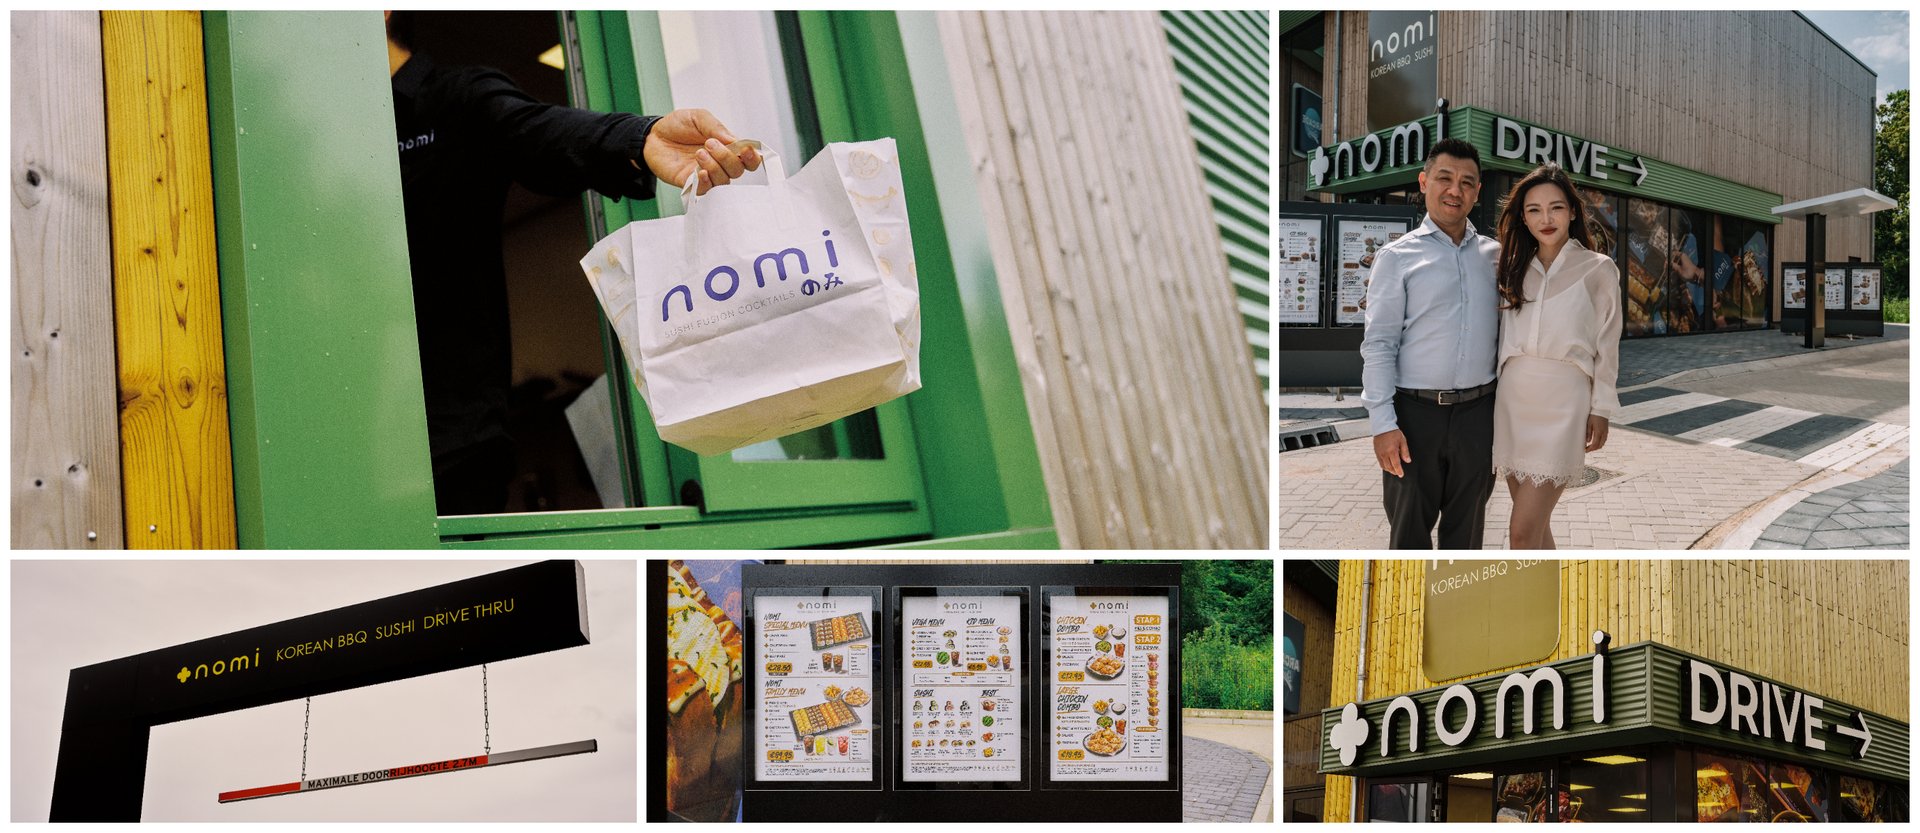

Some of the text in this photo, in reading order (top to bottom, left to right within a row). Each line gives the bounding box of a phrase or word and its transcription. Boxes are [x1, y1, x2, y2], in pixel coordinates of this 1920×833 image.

[1371, 9, 1434, 63] nomi
[1370, 45, 1434, 79] KOREAN BBQ SUSHI
[398, 129, 435, 152] nomi
[1334, 97, 1445, 180] nomi
[1496, 117, 1609, 180] DRIVE
[661, 229, 839, 322] nomi
[800, 272, 844, 296] のみ
[664, 290, 796, 339] SUSHI FUSION COCKTAILS
[1430, 569, 1479, 597] KOREAN
[1482, 560, 1508, 581] BBQ
[805, 601, 837, 610] nomi
[952, 601, 983, 610] nomi
[1098, 601, 1129, 610] nomi
[1136, 616, 1155, 624] STAP
[195, 598, 515, 680] nomi KOREAN BBQ SUSHI DRIVE THRU
[1136, 635, 1155, 643] STAP
[1381, 630, 1605, 757] nomi
[1690, 659, 1826, 751] DRIVE
[307, 757, 478, 789] MAXIMALE DOORRIJHOOGTE 2.7M
